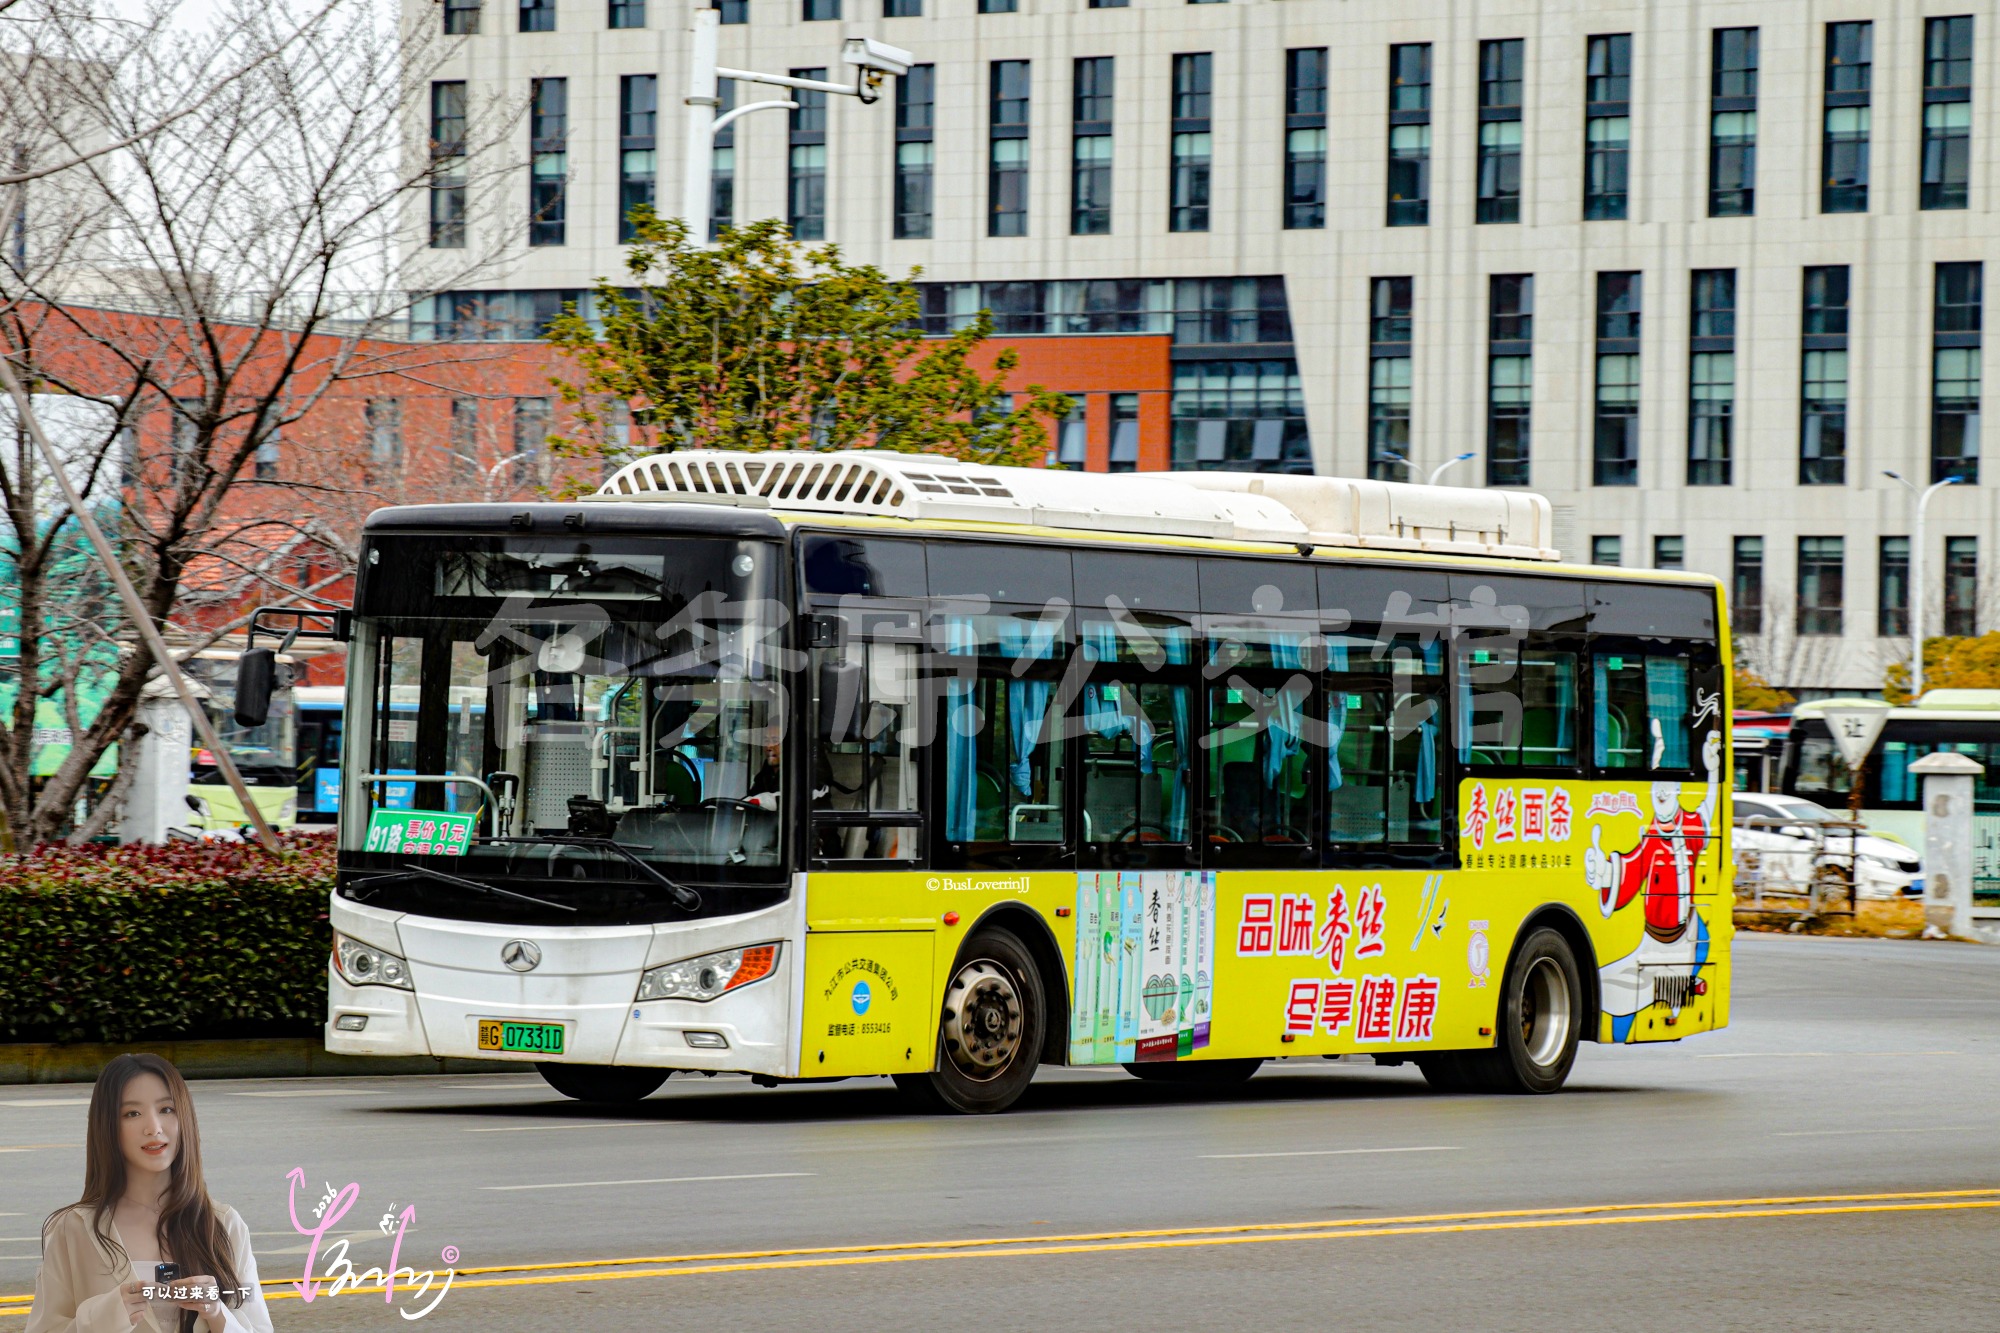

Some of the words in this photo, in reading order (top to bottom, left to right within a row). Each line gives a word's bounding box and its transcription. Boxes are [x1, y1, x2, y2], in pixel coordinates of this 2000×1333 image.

[1843, 717, 1865, 738] 让
[369, 824, 403, 853] 91路
[406, 820, 467, 842] 票价1元
[1463, 784, 1571, 848] 春丝面条
[1238, 886, 1386, 973] 品味春丝
[1286, 977, 1438, 1041] 尽享健康
